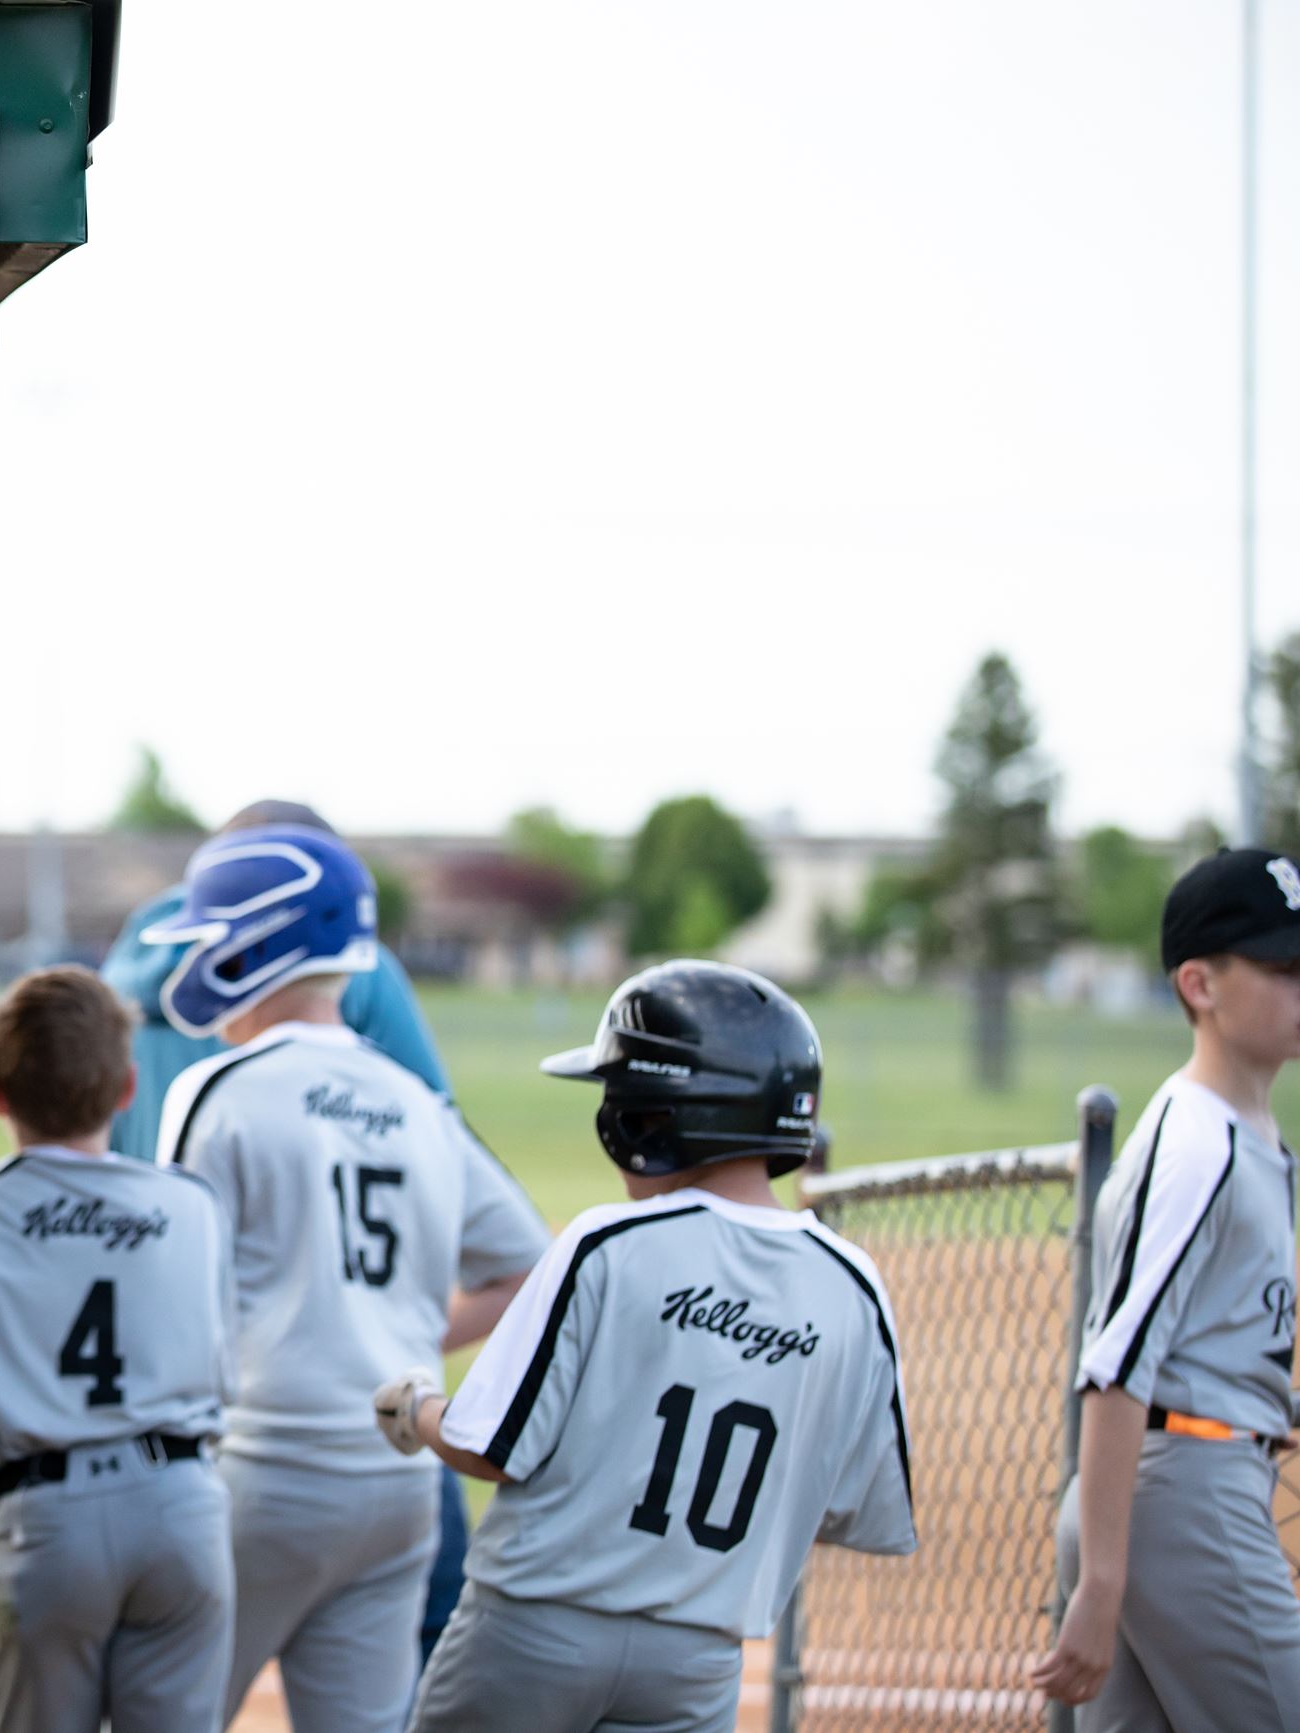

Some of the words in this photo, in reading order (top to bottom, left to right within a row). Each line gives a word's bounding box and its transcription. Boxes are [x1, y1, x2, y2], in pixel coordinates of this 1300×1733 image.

[21, 1196, 169, 1250] Kellogg's
[330, 1163, 404, 1288] 15
[57, 1277, 124, 1408] 4
[660, 1286, 821, 1365] Kellogg's
[628, 1384, 779, 1554] 10
